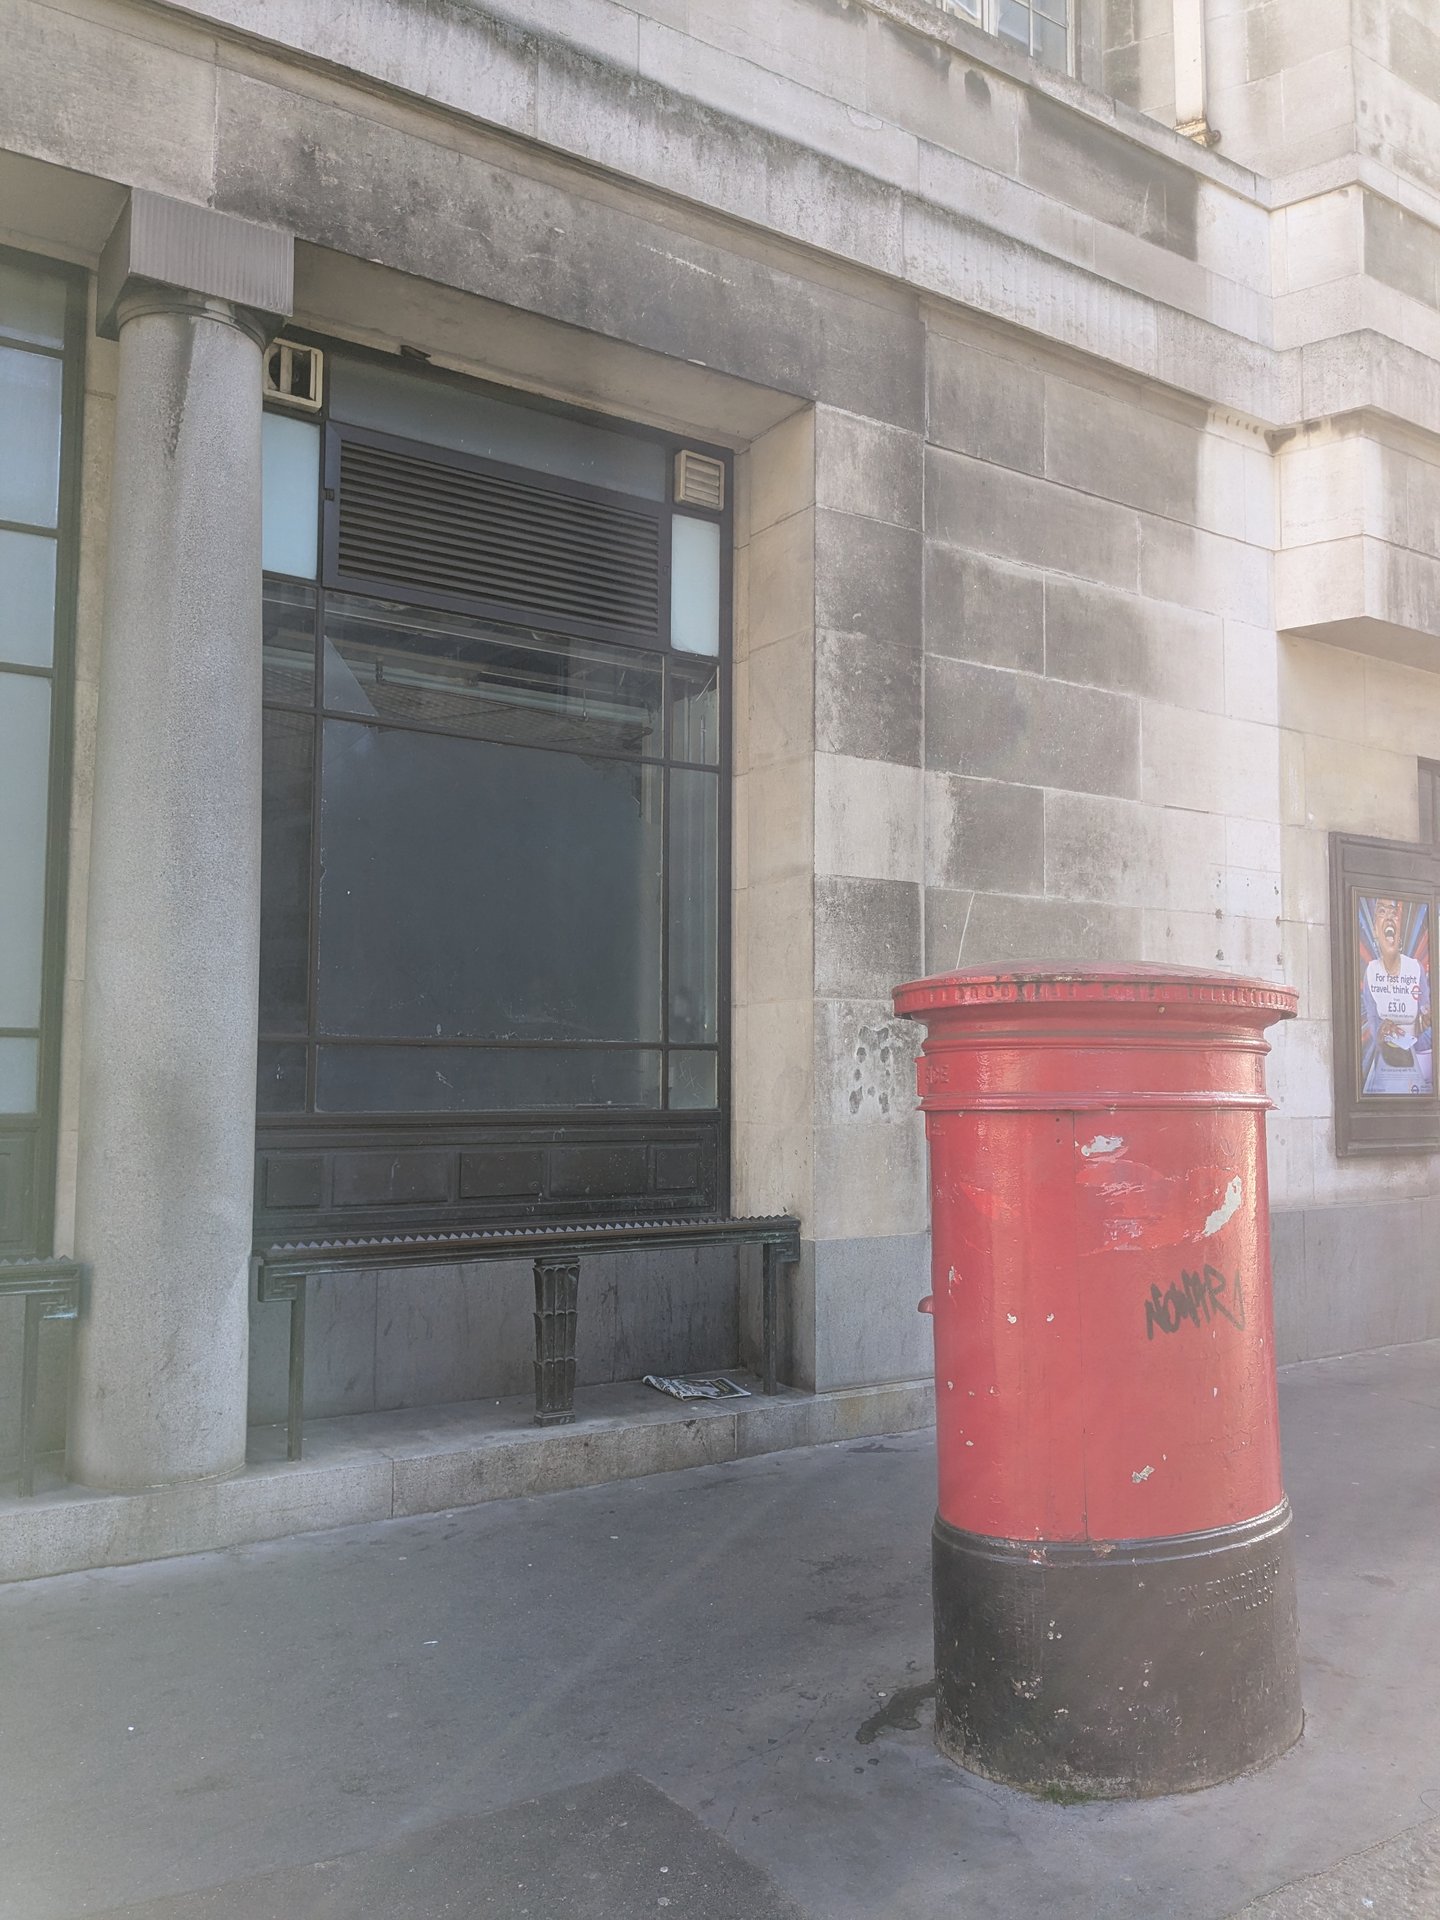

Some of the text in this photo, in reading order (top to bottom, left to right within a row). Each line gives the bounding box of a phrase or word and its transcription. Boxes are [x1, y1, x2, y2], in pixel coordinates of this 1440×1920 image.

[1375, 973, 1417, 985] For fast night
[1392, 985, 1410, 994] think
[1388, 1002, 1406, 1012] £3.10
